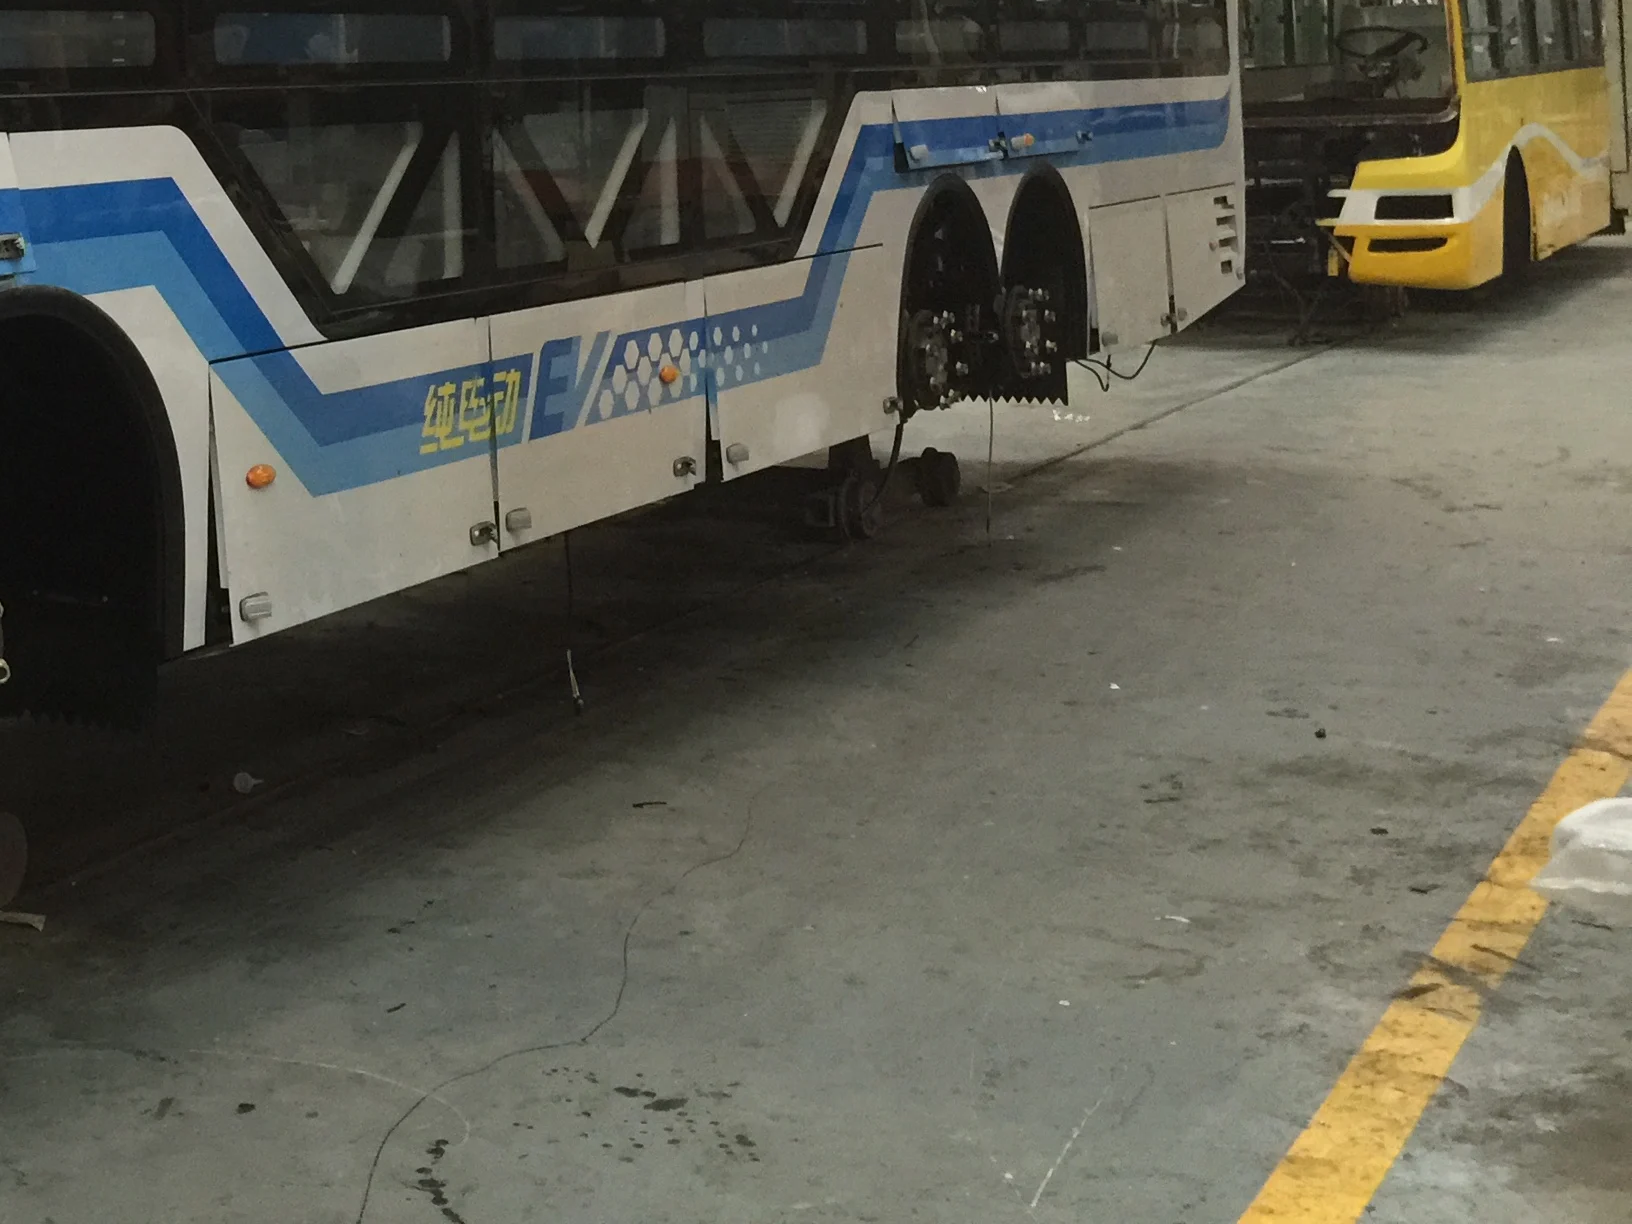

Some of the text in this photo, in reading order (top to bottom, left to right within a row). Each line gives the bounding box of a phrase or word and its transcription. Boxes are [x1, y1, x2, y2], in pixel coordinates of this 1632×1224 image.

[419, 330, 611, 455] 纯电动 EV
